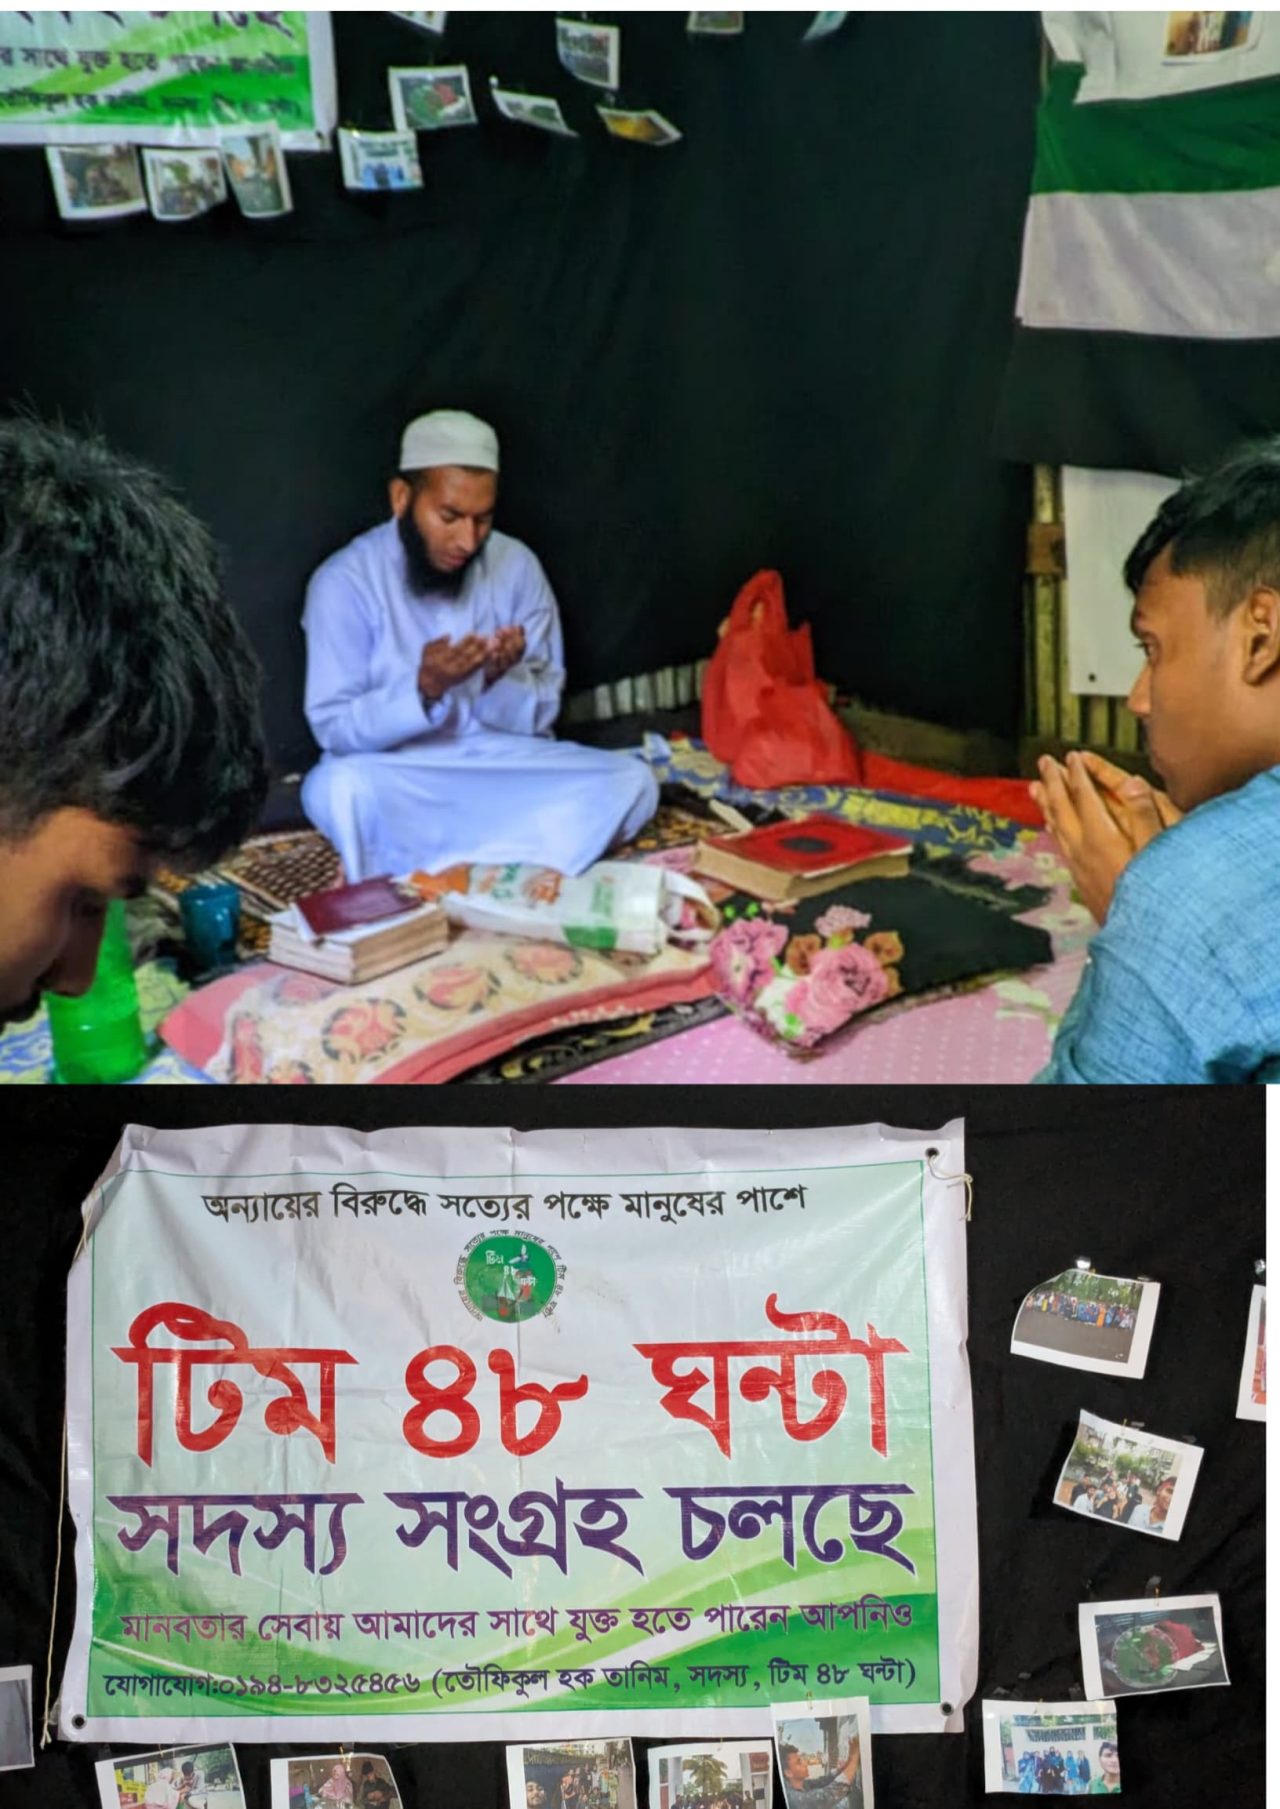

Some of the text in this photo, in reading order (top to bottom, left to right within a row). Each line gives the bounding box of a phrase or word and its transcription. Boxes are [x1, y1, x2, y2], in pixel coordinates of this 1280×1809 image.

[202, 1182, 807, 1224] অন্যায়ের বিরুদ্ধে সত্যের পক্ষে মানুষের পাশে
[110, 1292, 910, 1468] টিম ৪৮ ঘন্টা
[107, 1476, 916, 1577] সদস্য সংগ্রহ চলছে
[121, 1593, 913, 1643] মানবতার সেবায় আমাদের সাথে যুক্ত হতে পারেন আপনিও
[431, 1663, 548, 1699] (তৌফিকুল
[556, 1667, 596, 1690] হক
[768, 1655, 809, 1686] টিম
[816, 1664, 850, 1686] ৪৮
[857, 1654, 917, 1690] ঘন্টা)
